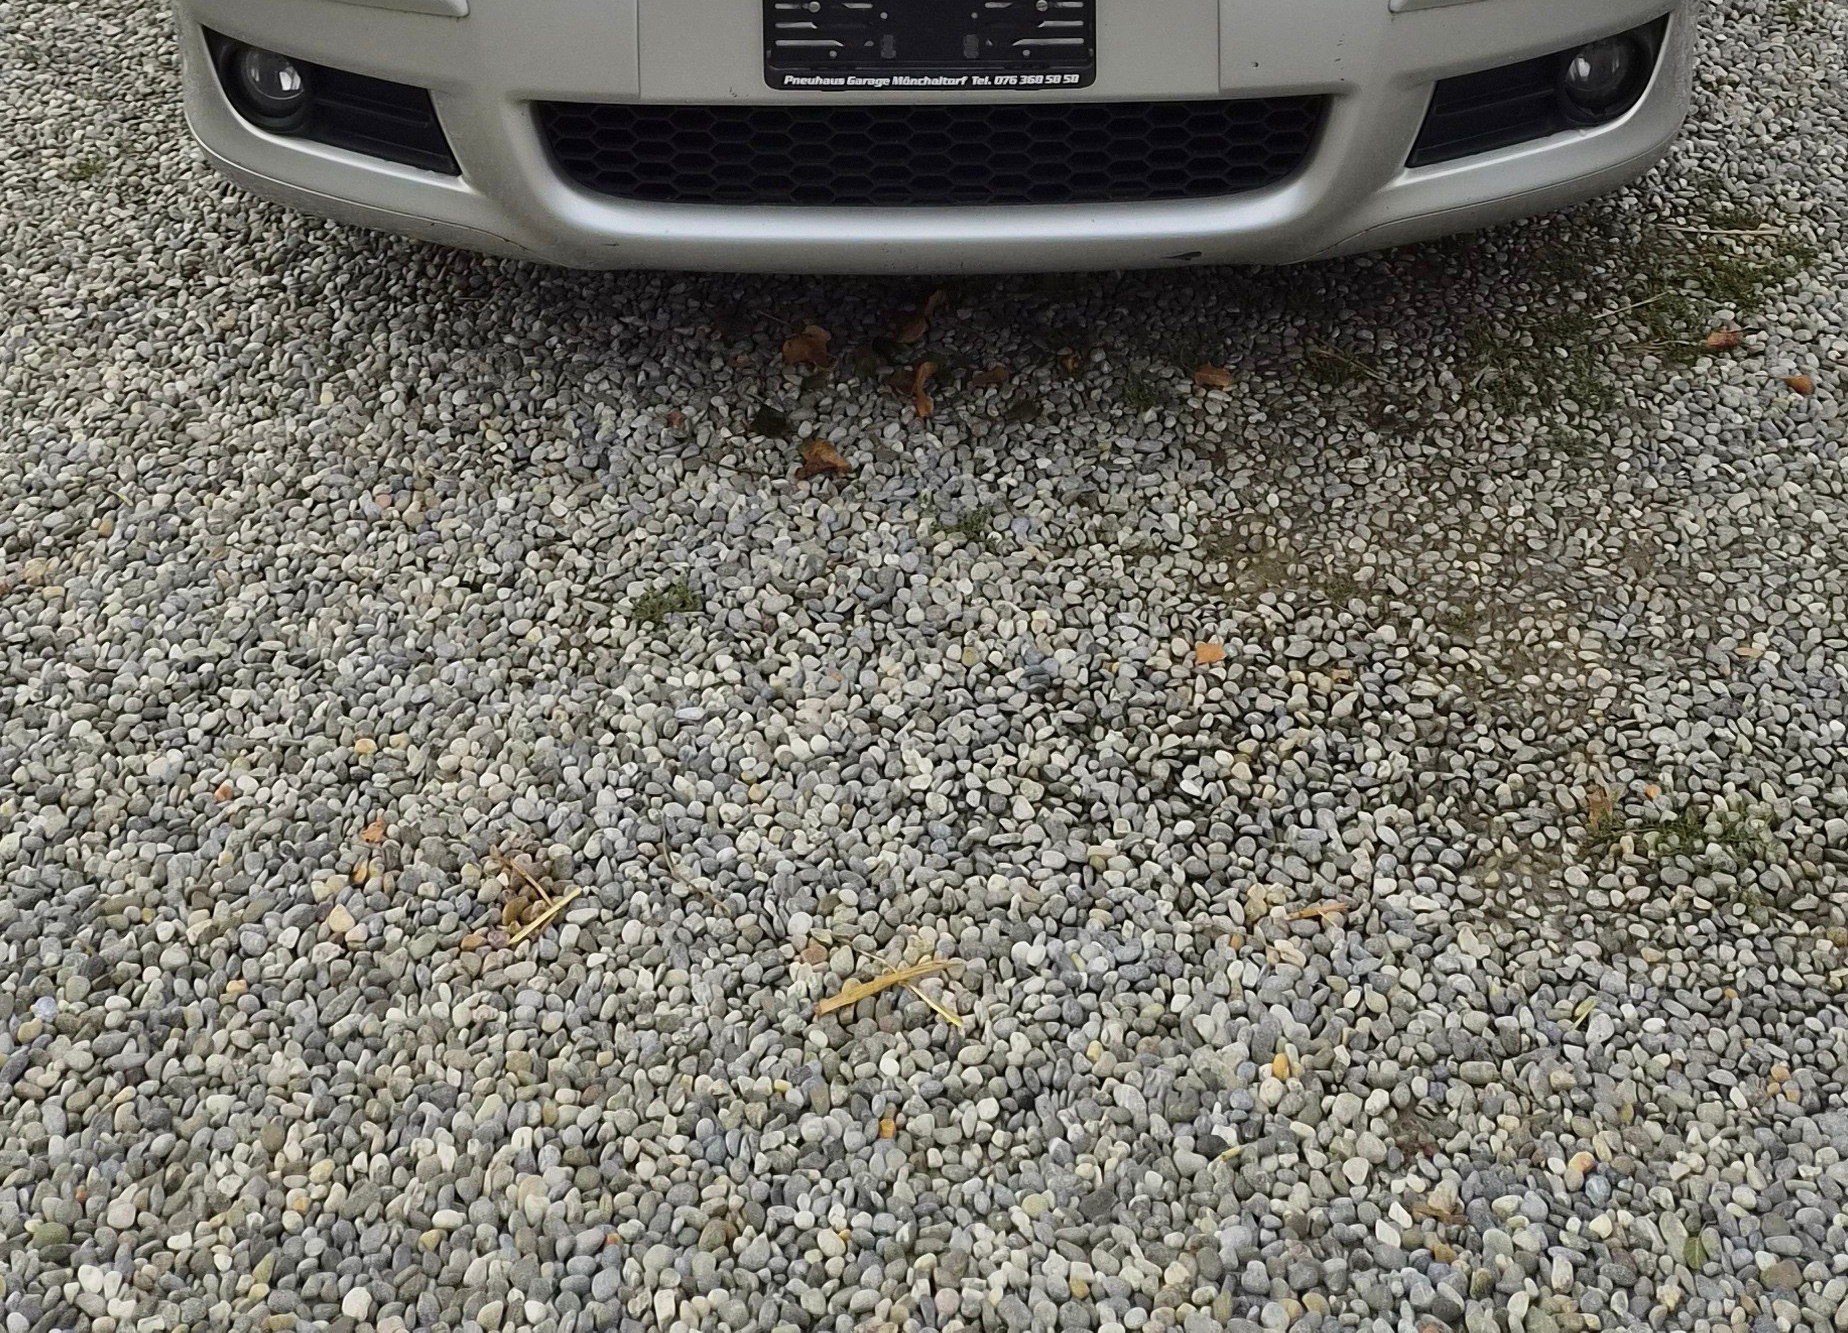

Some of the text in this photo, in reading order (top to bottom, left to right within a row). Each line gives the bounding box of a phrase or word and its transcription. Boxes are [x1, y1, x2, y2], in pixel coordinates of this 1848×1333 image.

[783, 75, 845, 86] Pneuhaus
[846, 75, 890, 88] Garage
[971, 75, 992, 86] Tel.
[993, 75, 1018, 86] 076
